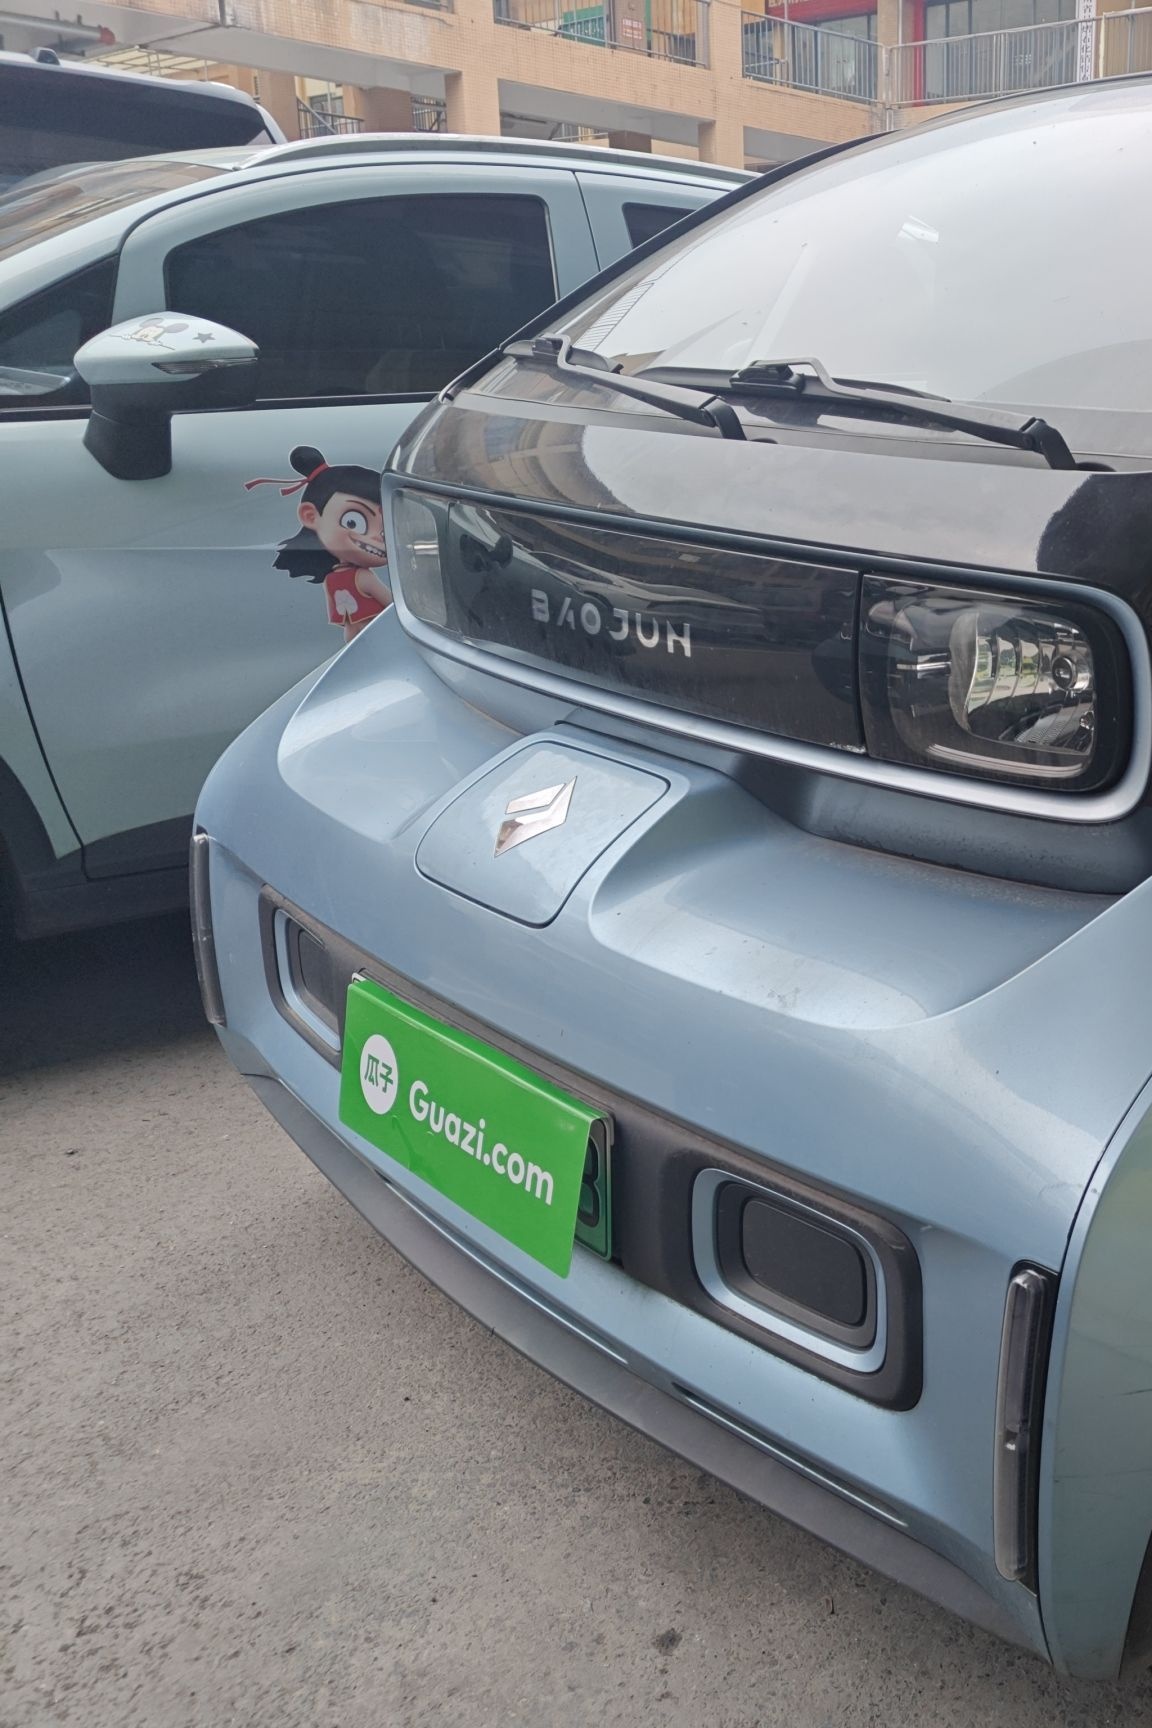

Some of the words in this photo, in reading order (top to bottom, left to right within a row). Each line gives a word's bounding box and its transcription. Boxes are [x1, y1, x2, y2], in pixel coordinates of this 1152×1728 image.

[530, 588, 692, 658] BAOJUN
[364, 1053, 394, 1093] 瓜子
[409, 1080, 554, 1205] Guazi.com
